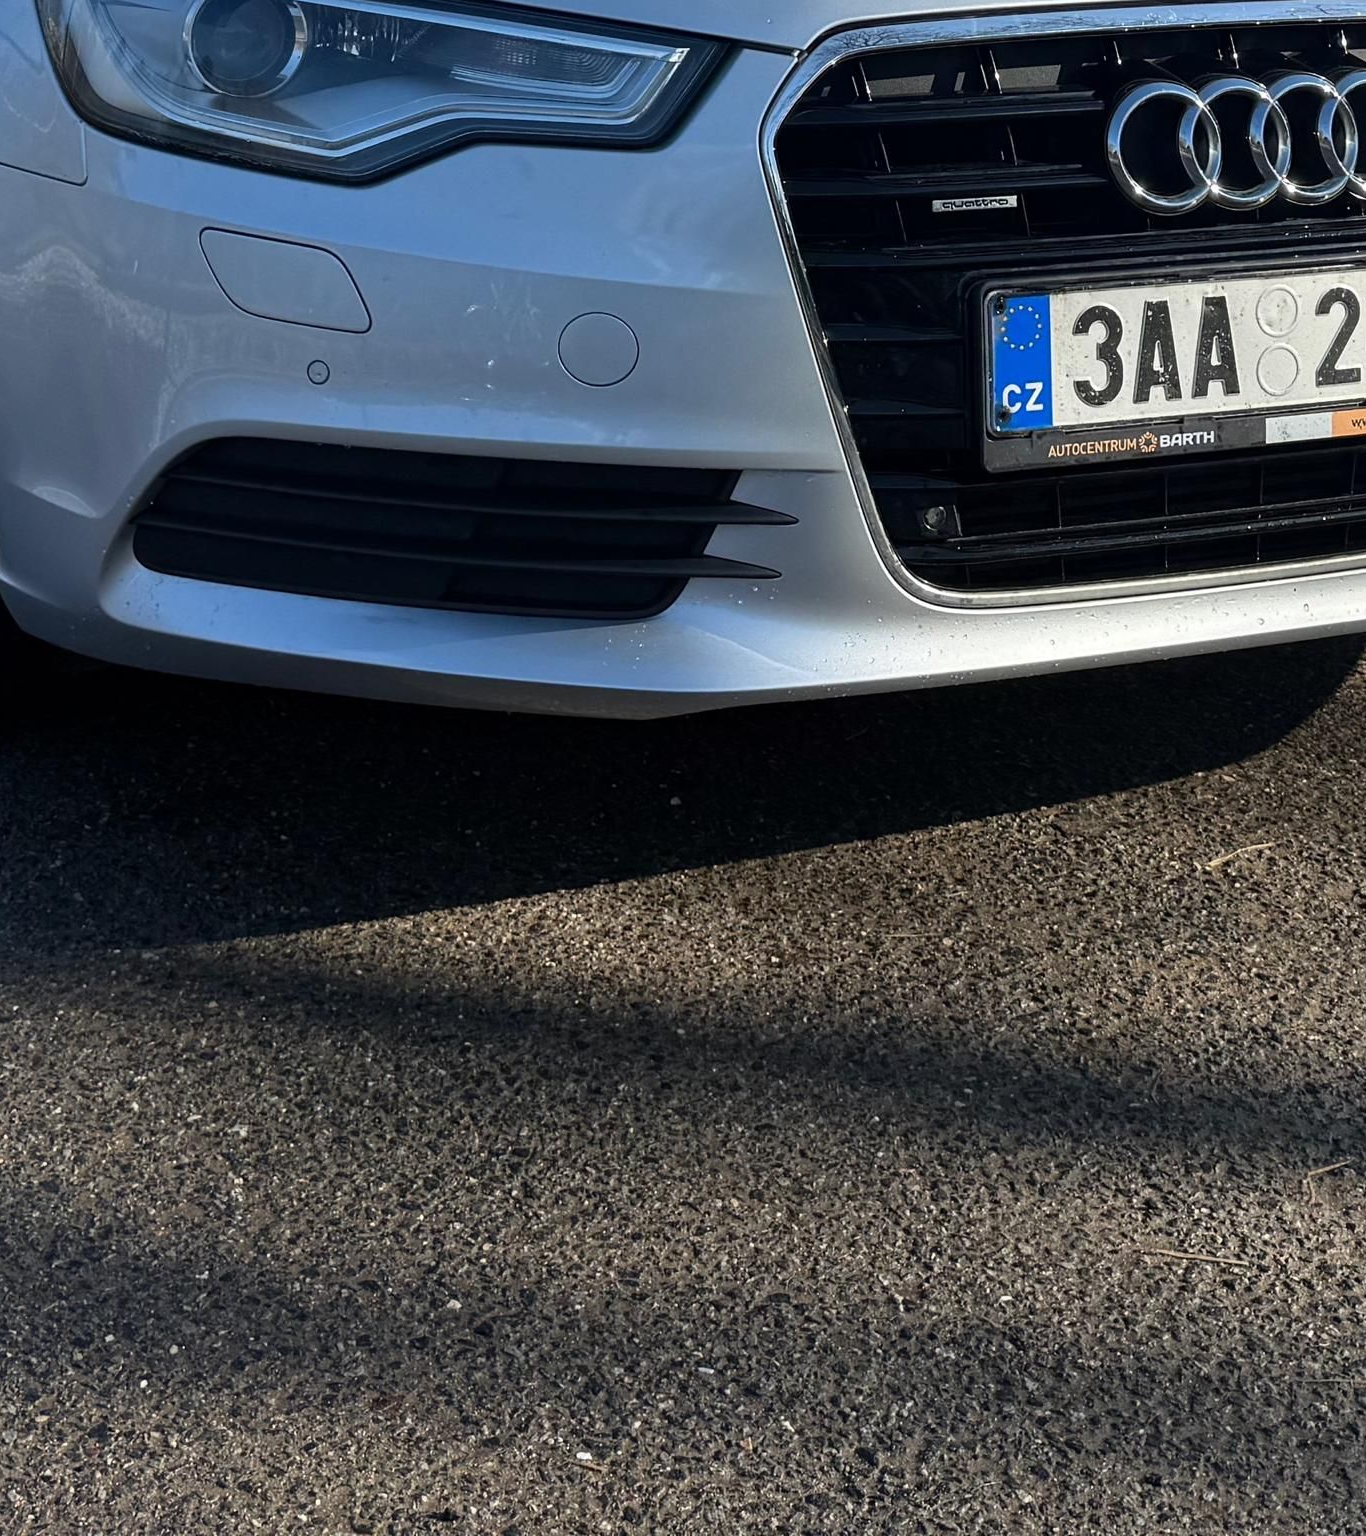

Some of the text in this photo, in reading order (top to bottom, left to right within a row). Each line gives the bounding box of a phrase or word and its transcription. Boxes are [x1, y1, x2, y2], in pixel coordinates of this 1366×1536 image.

[941, 198, 1009, 210] quattro
[1072, 295, 1241, 408] 3AA
[1002, 381, 1044, 414] CZ
[1048, 430, 1215, 458] AUTOCENTRUM BARTH
